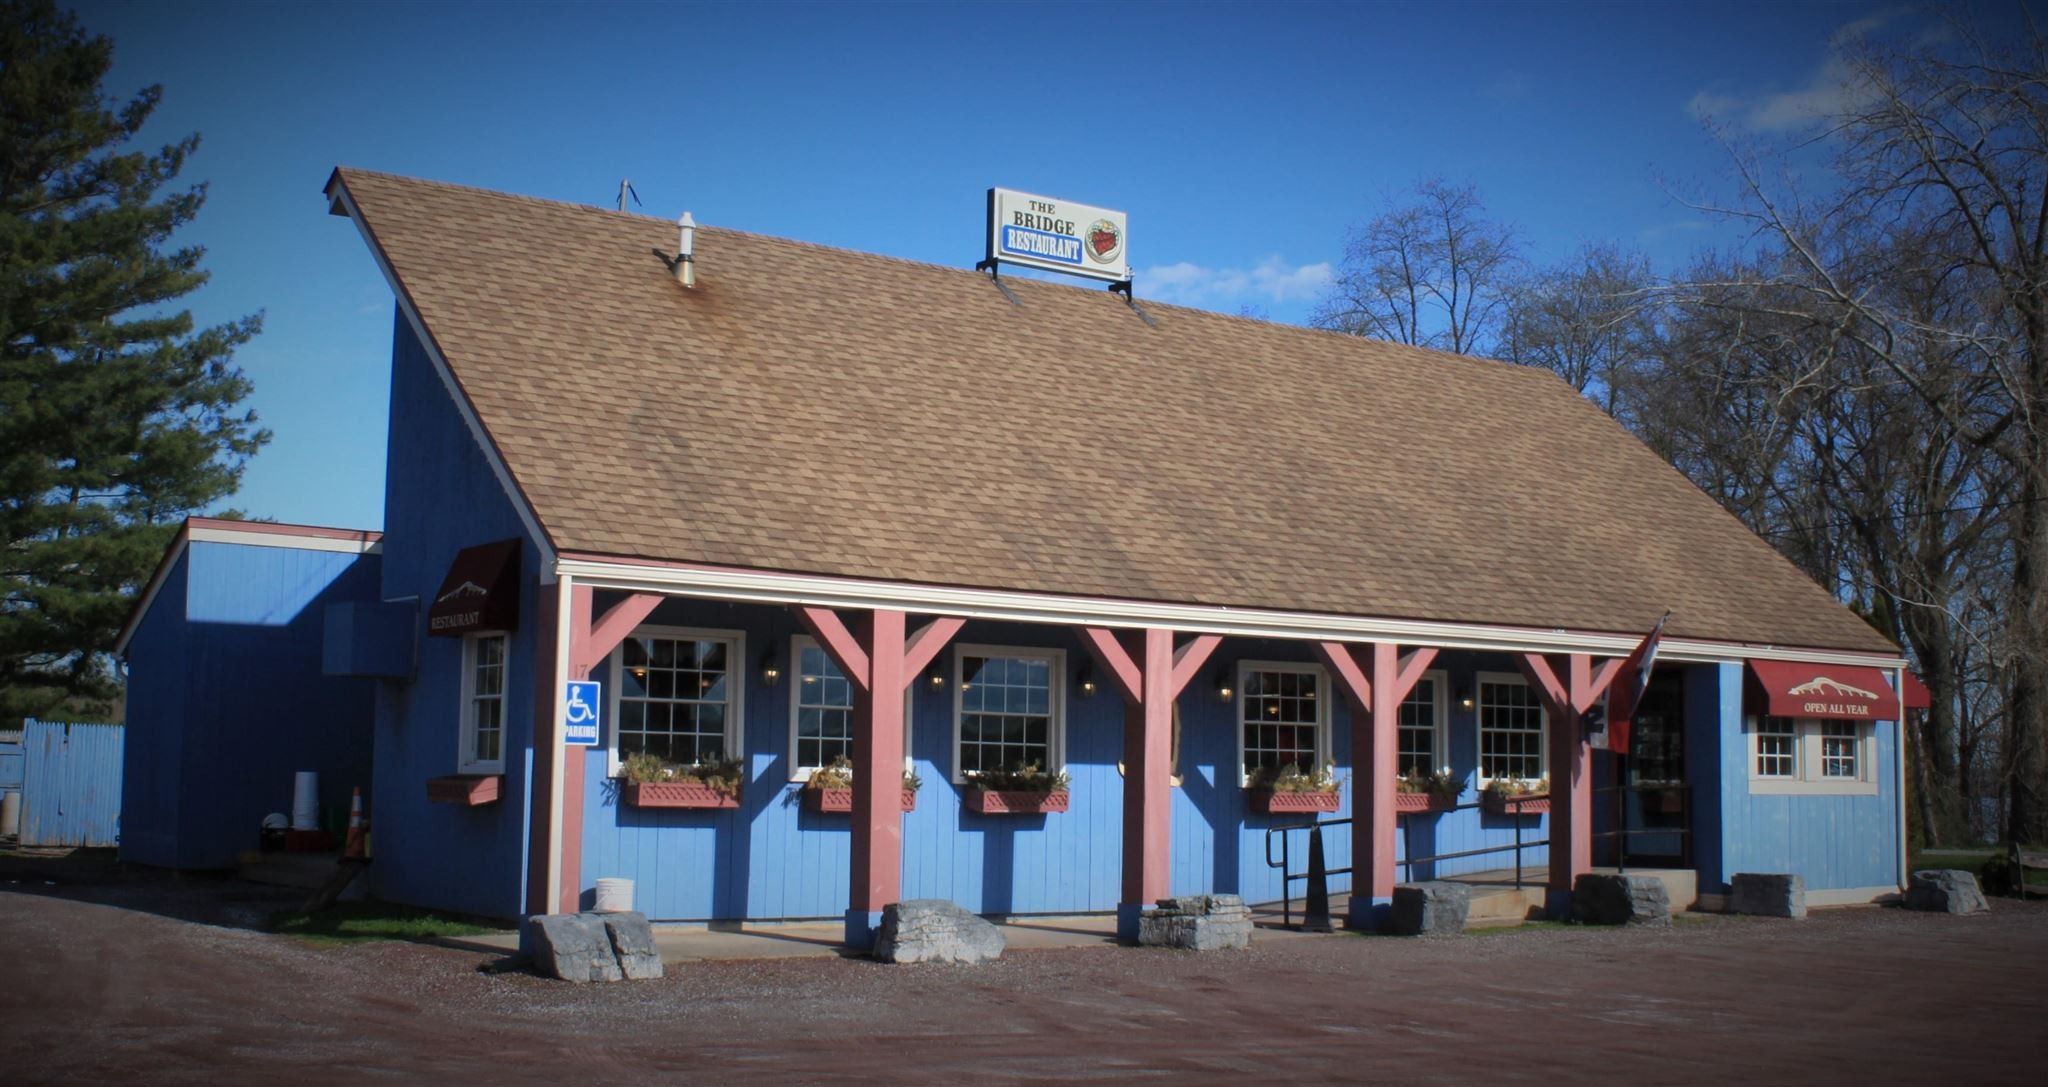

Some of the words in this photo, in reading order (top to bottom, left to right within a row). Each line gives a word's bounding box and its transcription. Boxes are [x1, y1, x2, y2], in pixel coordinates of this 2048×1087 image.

[1029, 200, 1056, 215] THE
[1013, 210, 1075, 236] BRIDGE
[1007, 228, 1080, 260] RESTAURANT
[431, 611, 480, 630] RESTAURANT
[1804, 702, 1827, 713] OPEN
[1828, 704, 1845, 714] ALL
[1846, 705, 1869, 716] YEAR
[565, 726, 596, 738] PARKING
